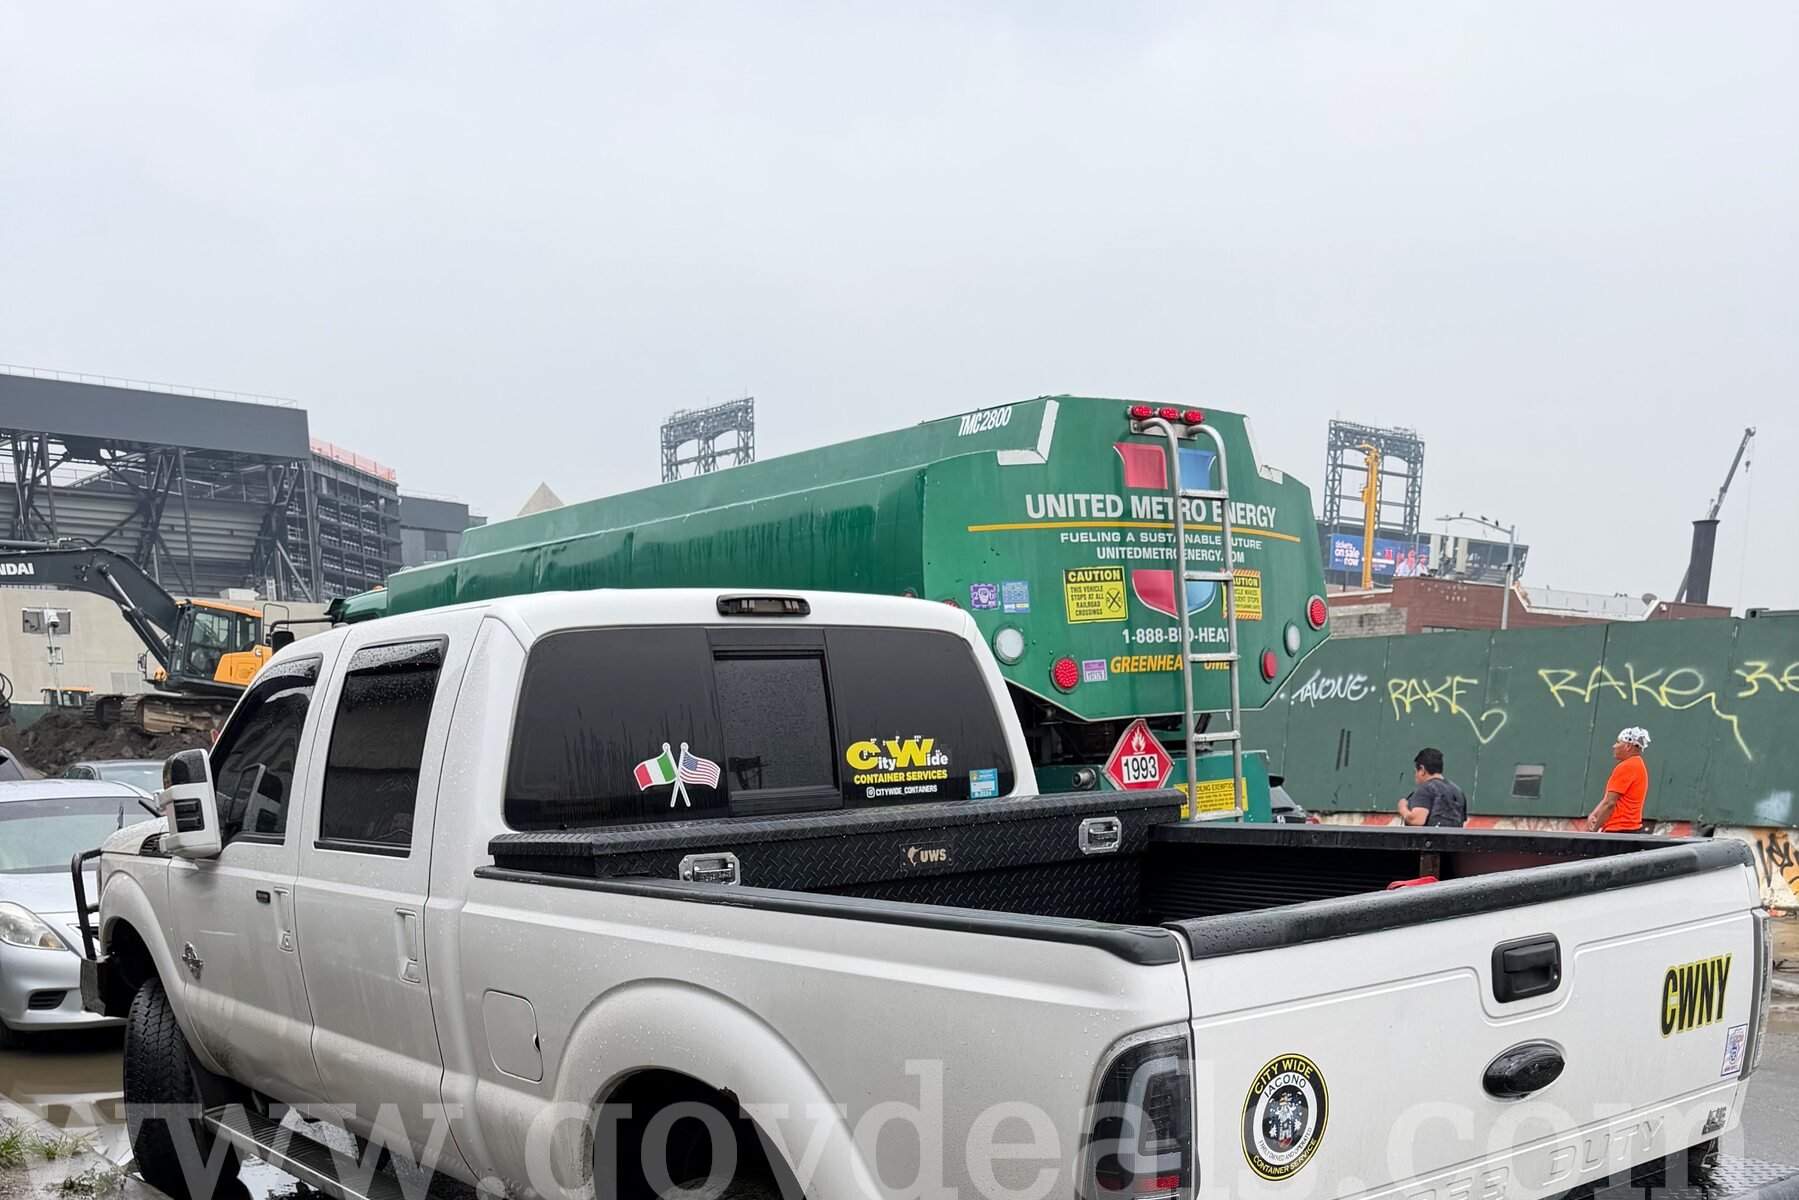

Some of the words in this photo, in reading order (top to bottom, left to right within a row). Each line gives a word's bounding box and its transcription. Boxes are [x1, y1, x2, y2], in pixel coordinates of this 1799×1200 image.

[958, 406, 1012, 437] TMC2800
[1025, 494, 1124, 519] UNITED
[1130, 496, 1207, 522] METRO
[1060, 532, 1121, 543] FUELING
[1126, 532, 1135, 543] A
[1140, 532, 1222, 546] SUSTNABLE
[1230, 538, 1262, 550] UTURE
[1345, 547, 1360, 559] sale
[1343, 558, 1360, 567] now
[1068, 569, 1121, 582] CAUTION
[1111, 655, 1184, 674] GREENHEA
[854, 772, 905, 785] CONTAINER
[906, 769, 948, 782] SERVICES
[1124, 756, 1157, 781] 1993
[920, 848, 947, 863] UWS
[1660, 953, 1733, 1038] CWNY
[1254, 1063, 1280, 1095] CITY
[1282, 1059, 1313, 1079] WIDE
[1264, 1074, 1307, 1099] IACONO
[1253, 1155, 1290, 1175] CONTAINER
[1290, 1138, 1317, 1170] SERVICE
[1542, 1115, 1665, 1187] DUTY
